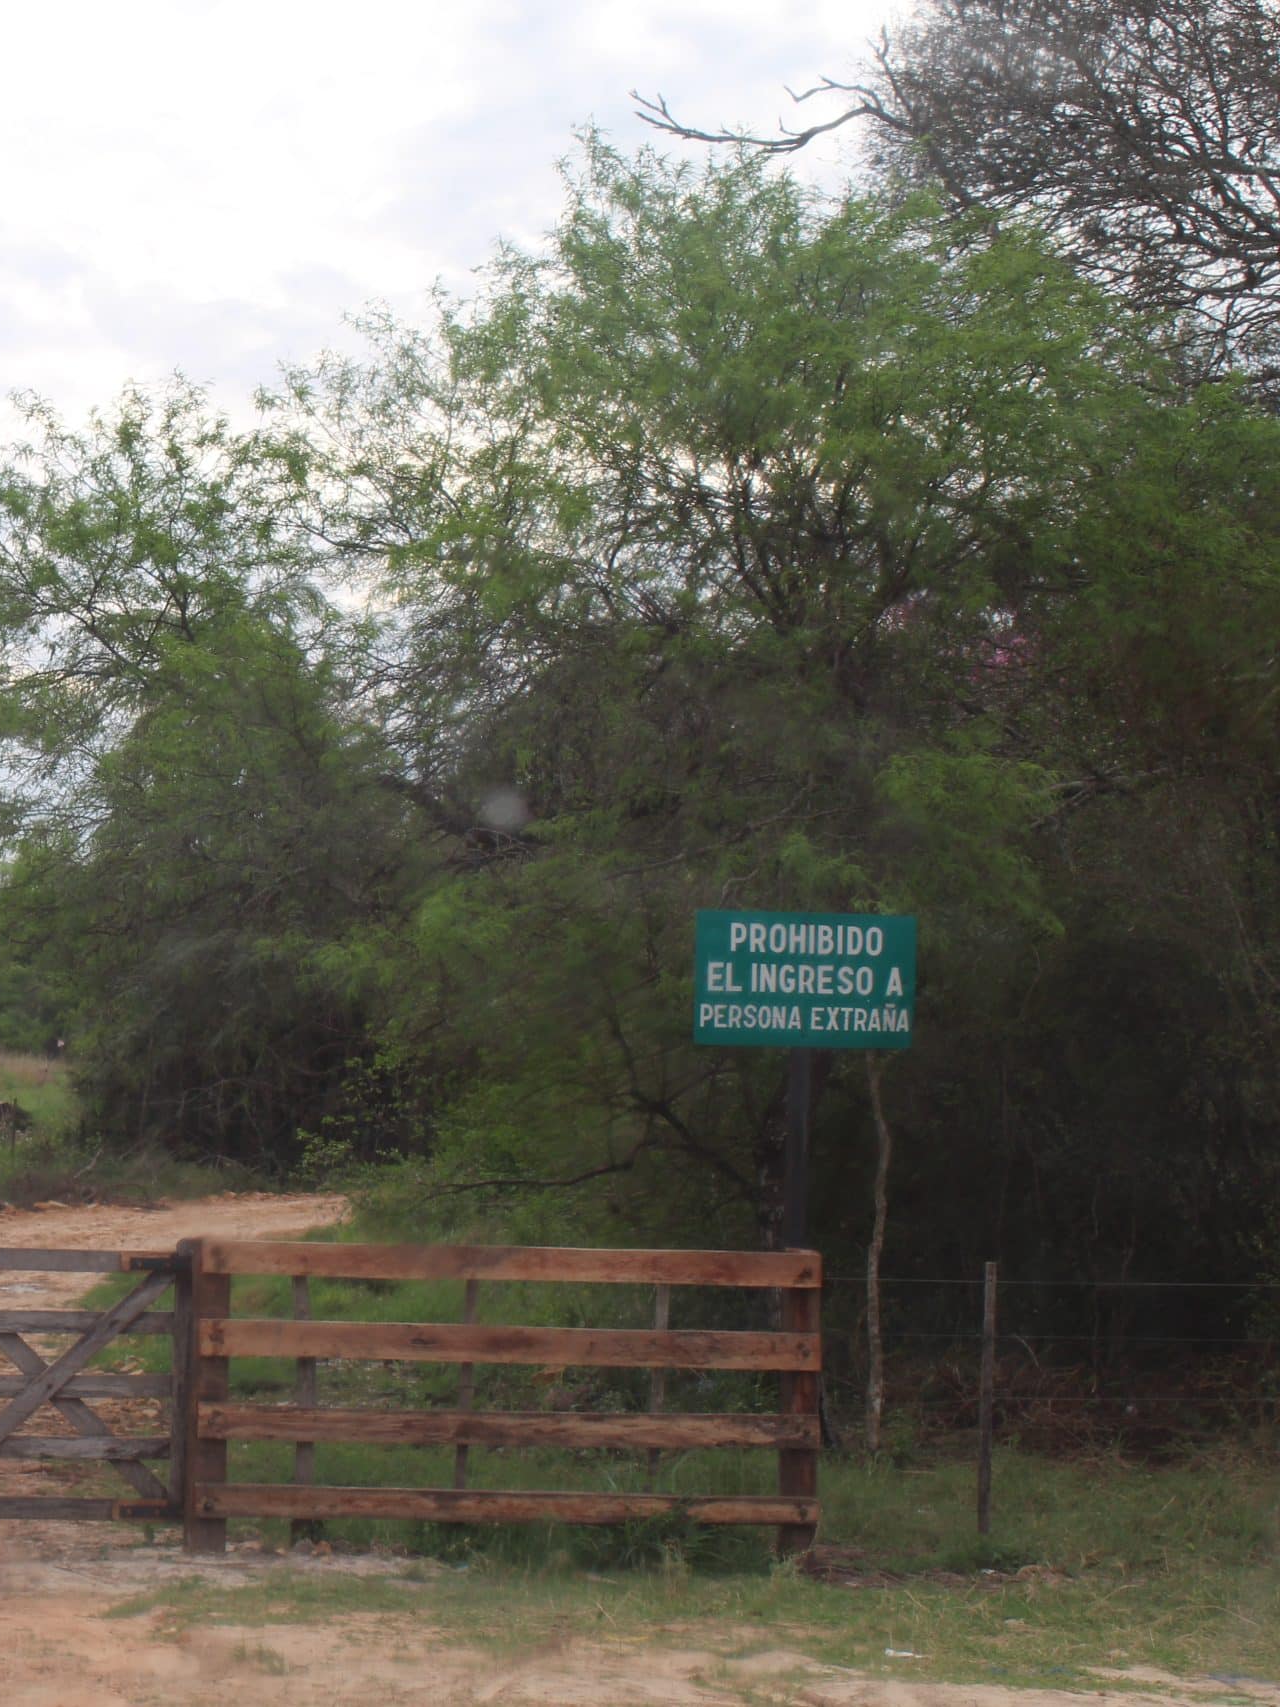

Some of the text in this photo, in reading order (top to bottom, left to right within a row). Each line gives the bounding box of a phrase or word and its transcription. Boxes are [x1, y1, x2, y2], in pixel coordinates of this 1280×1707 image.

[730, 922, 883, 956] PROHIBIDO
[707, 961, 903, 996] EL INGRESO A
[700, 1003, 909, 1032] PERSONA EXTRAÑA
